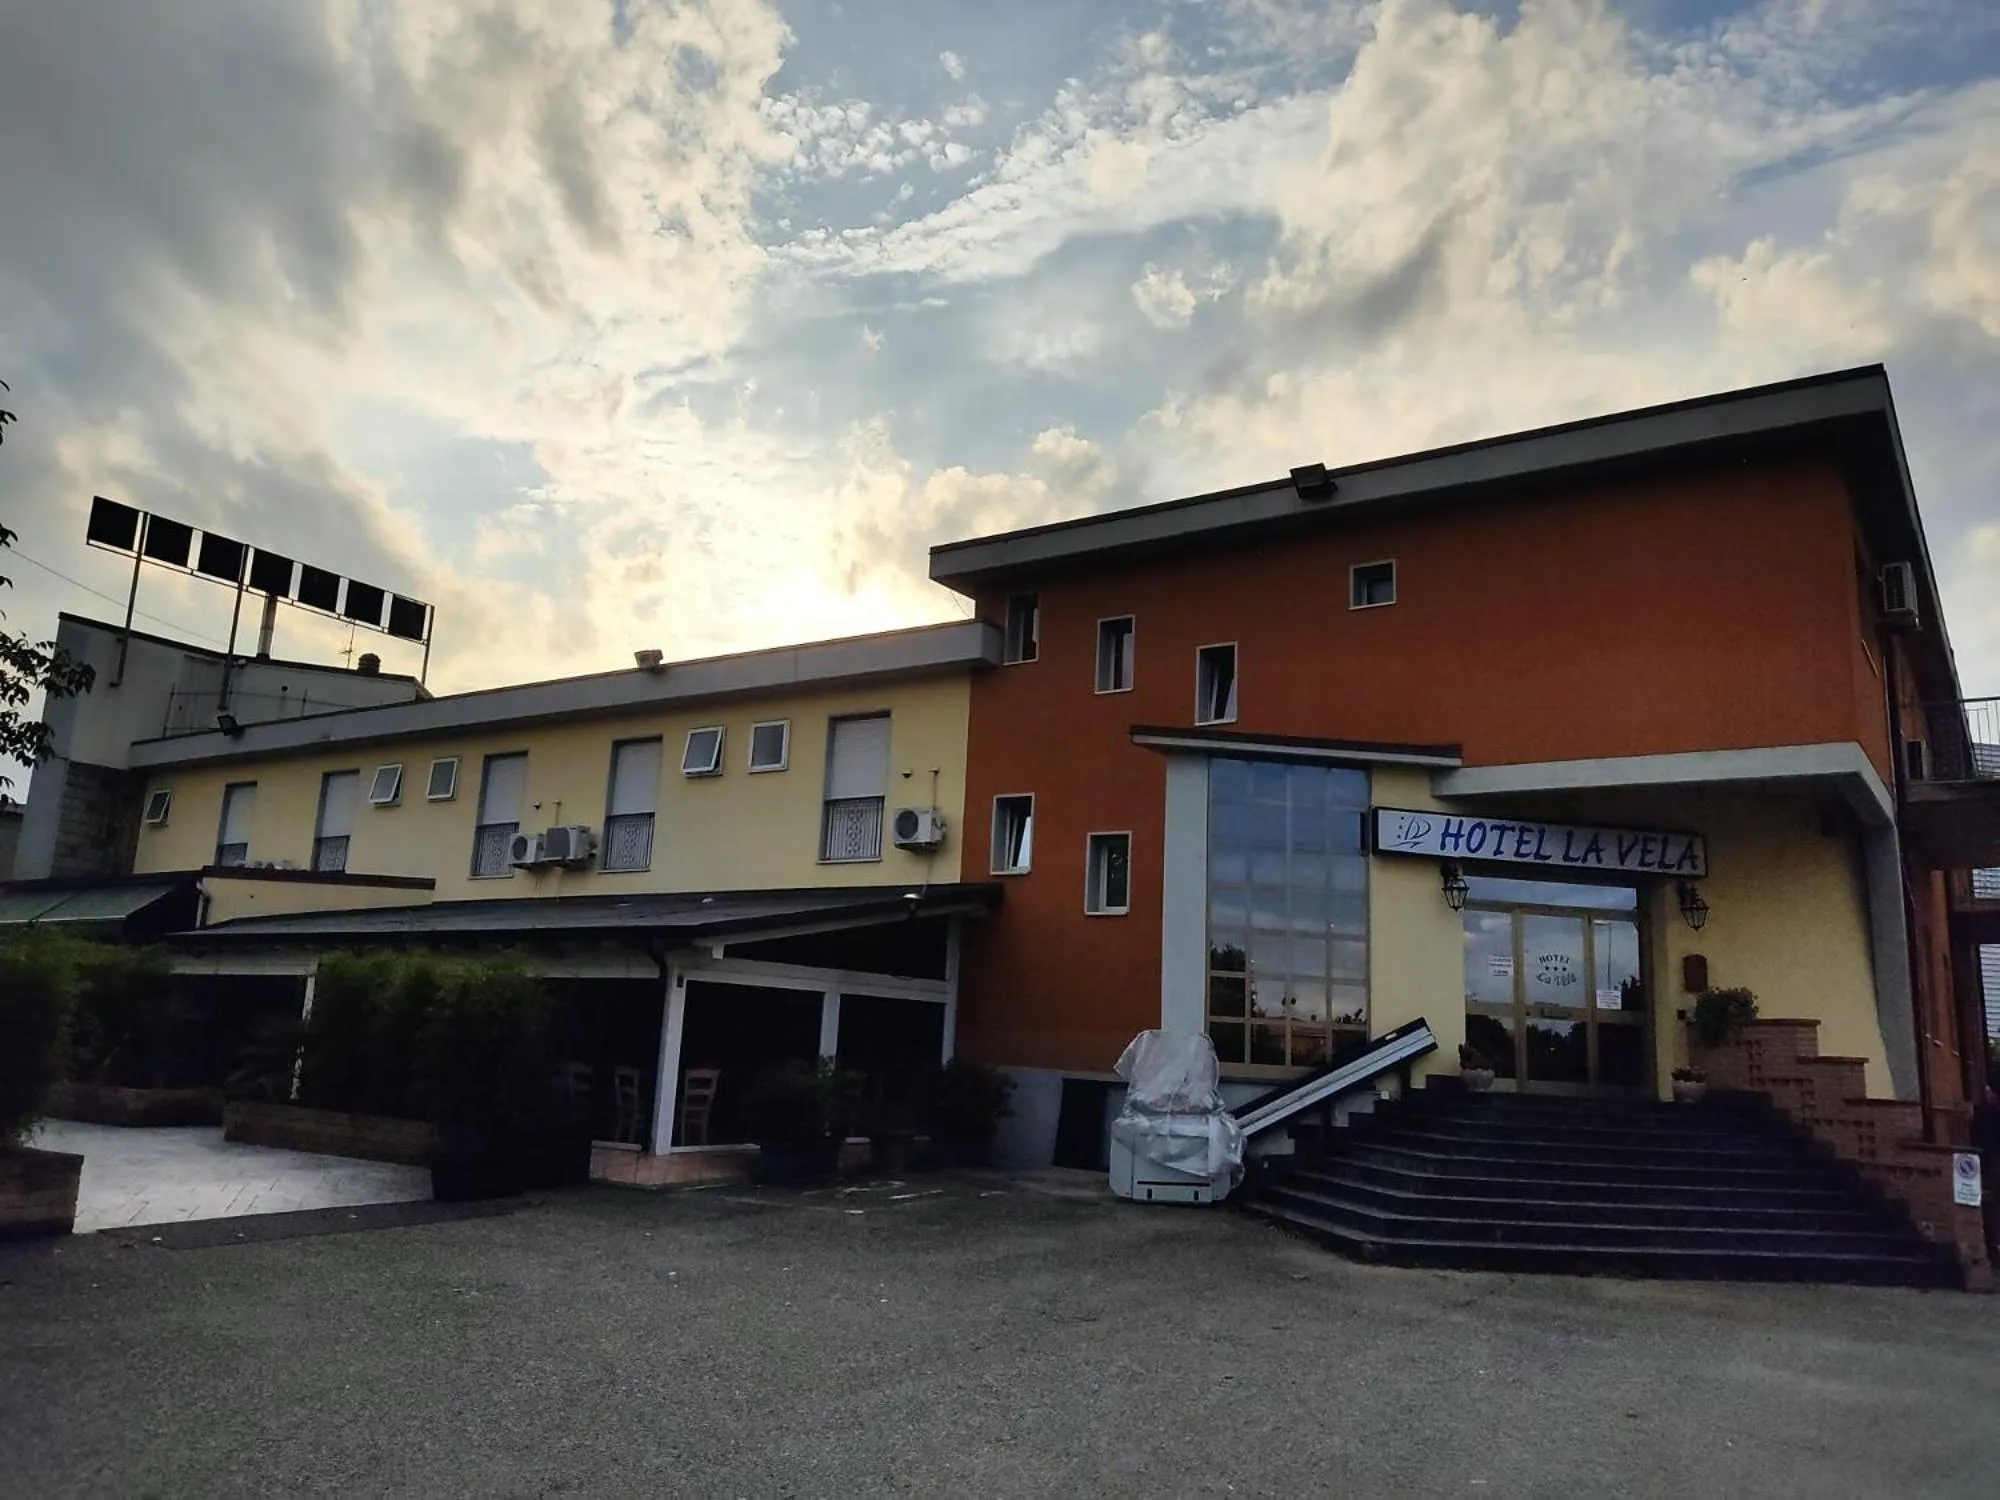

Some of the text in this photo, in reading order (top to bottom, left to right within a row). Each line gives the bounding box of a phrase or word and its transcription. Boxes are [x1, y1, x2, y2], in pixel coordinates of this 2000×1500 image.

[1440, 818, 1698, 870] HOTEL LA VELA
[1538, 953, 1570, 964] HOTEL
